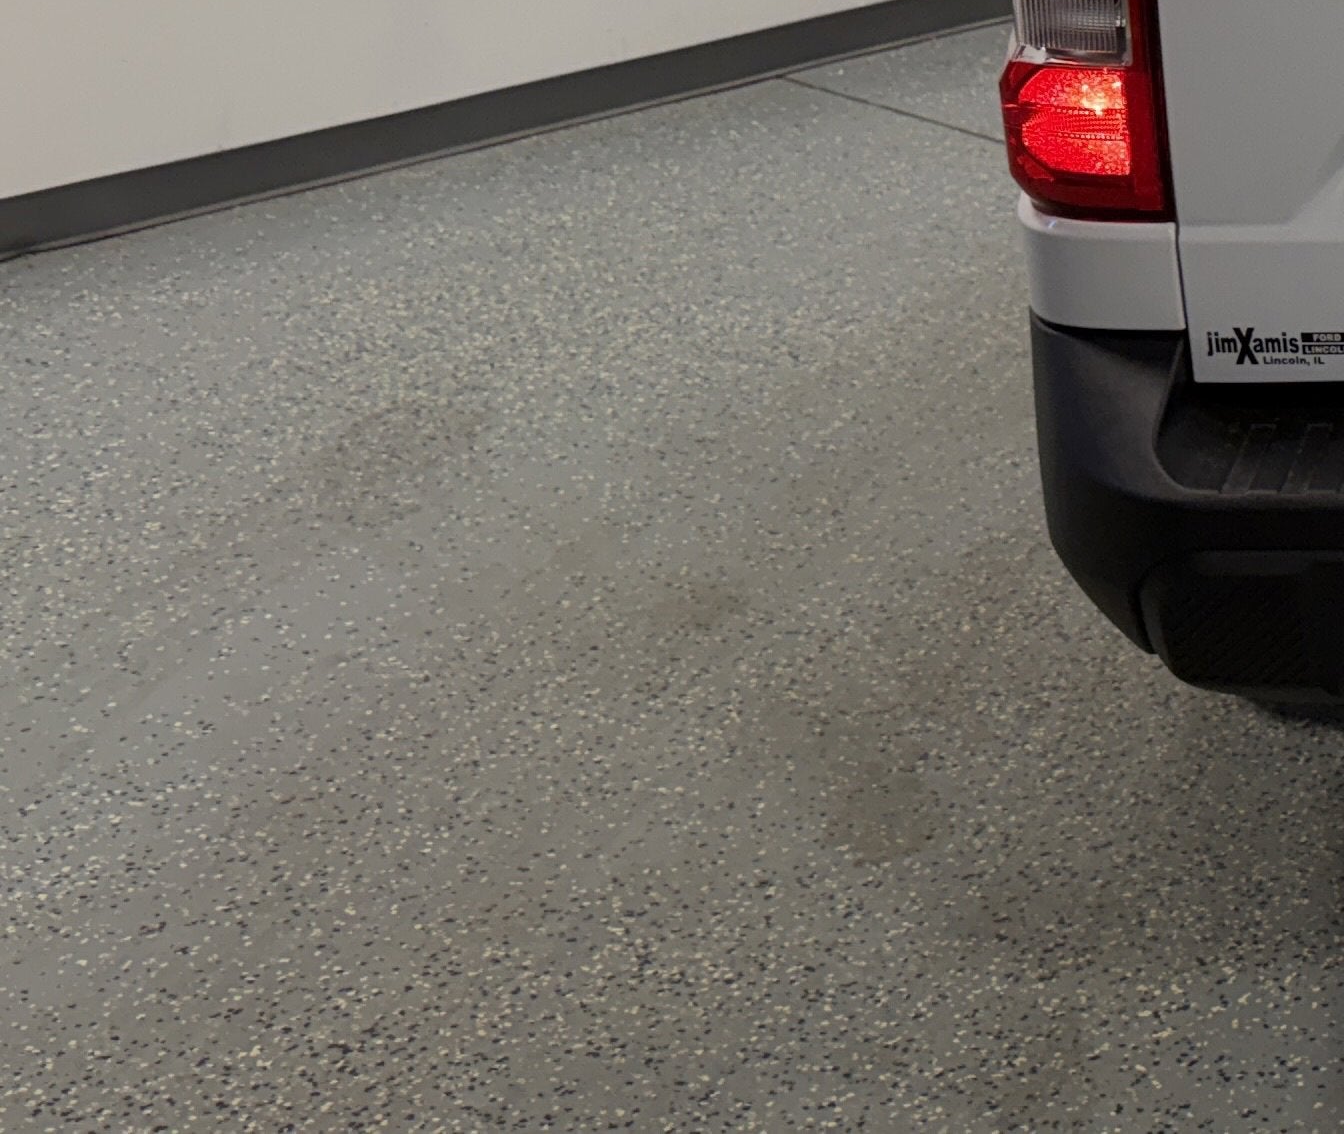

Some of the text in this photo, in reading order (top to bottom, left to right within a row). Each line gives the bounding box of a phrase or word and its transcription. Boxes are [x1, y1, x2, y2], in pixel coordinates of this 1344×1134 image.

[1312, 333, 1342, 342] FORD
[1263, 356, 1325, 366] Lincoln, IL
